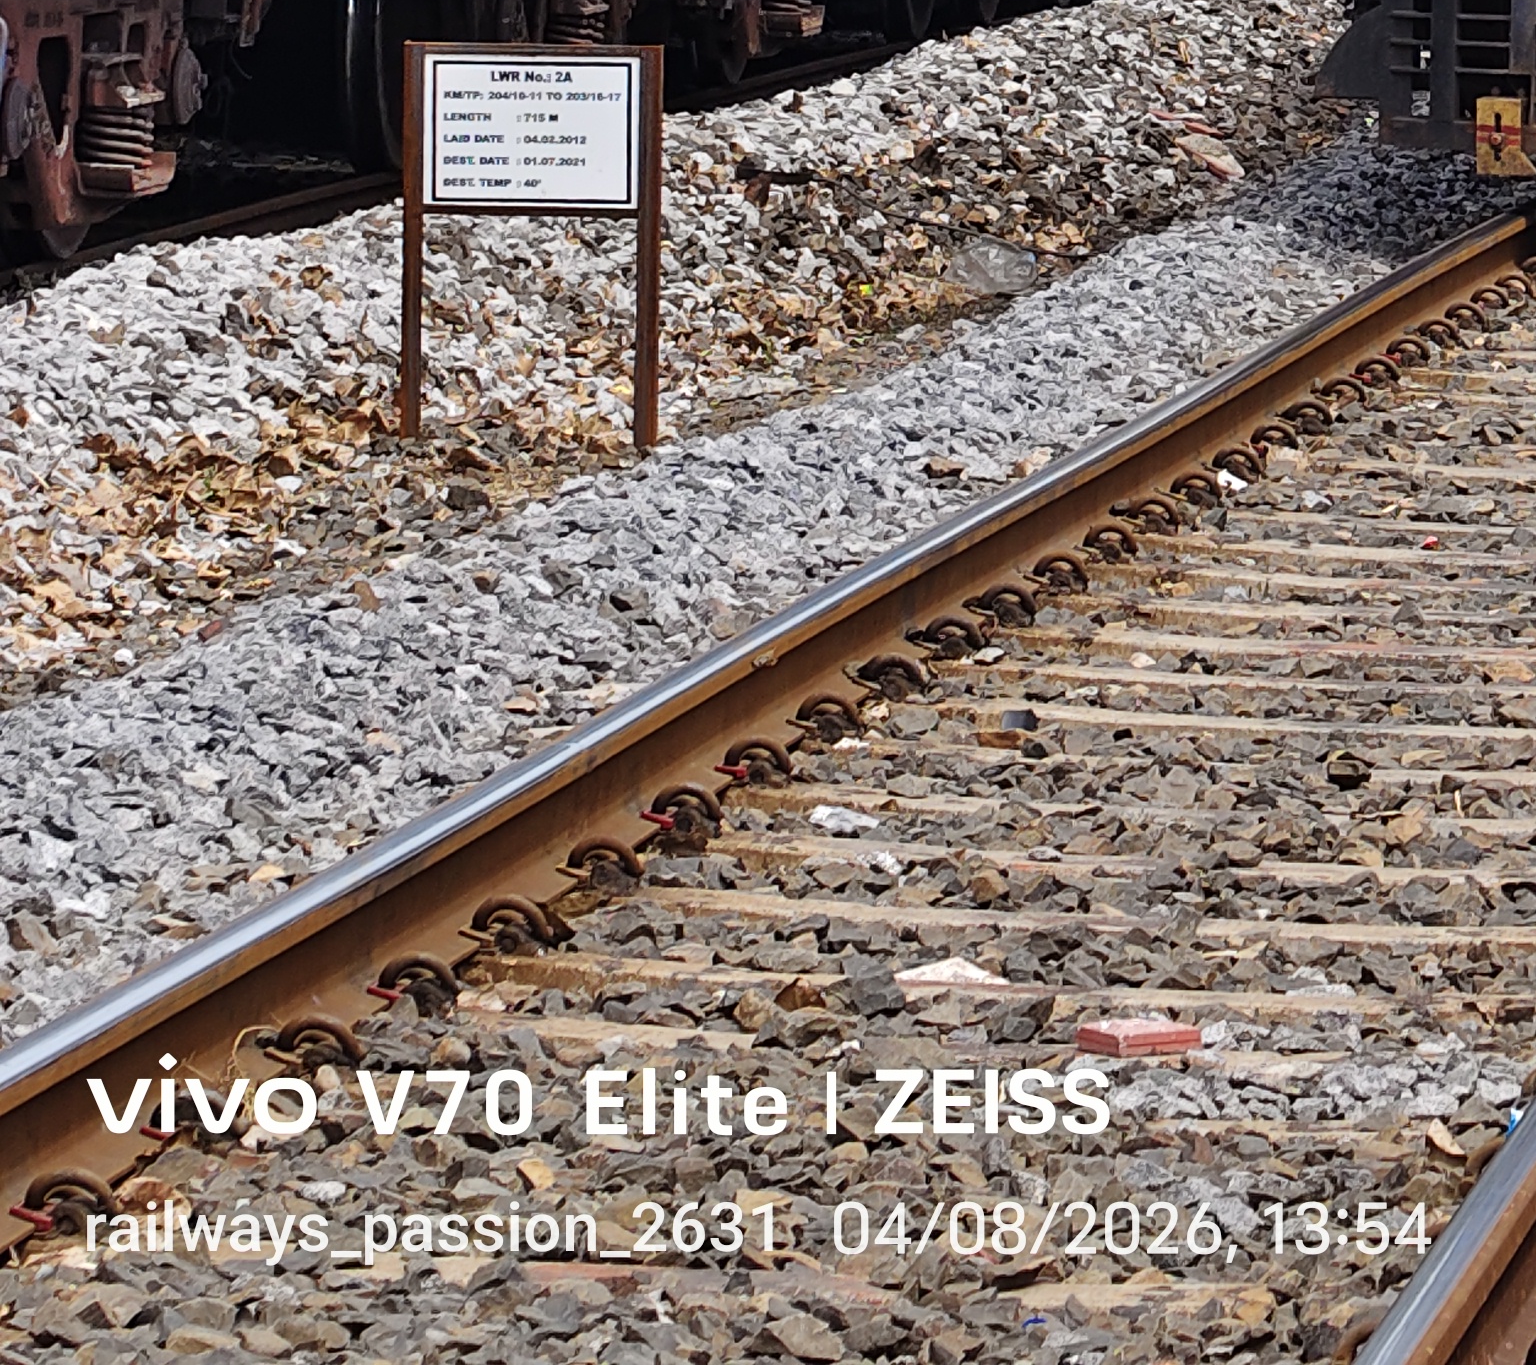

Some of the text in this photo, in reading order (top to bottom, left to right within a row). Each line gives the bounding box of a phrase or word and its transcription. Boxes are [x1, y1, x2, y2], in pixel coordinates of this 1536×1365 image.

[491, 71, 521, 82] LWR
[555, 71, 573, 82] 2A
[546, 92, 562, 101] TO
[443, 113, 492, 122] LENGTH
[443, 134, 471, 143] LAID
[474, 134, 505, 144] DATE
[479, 156, 510, 165] DATE
[479, 178, 512, 187] TEMP
